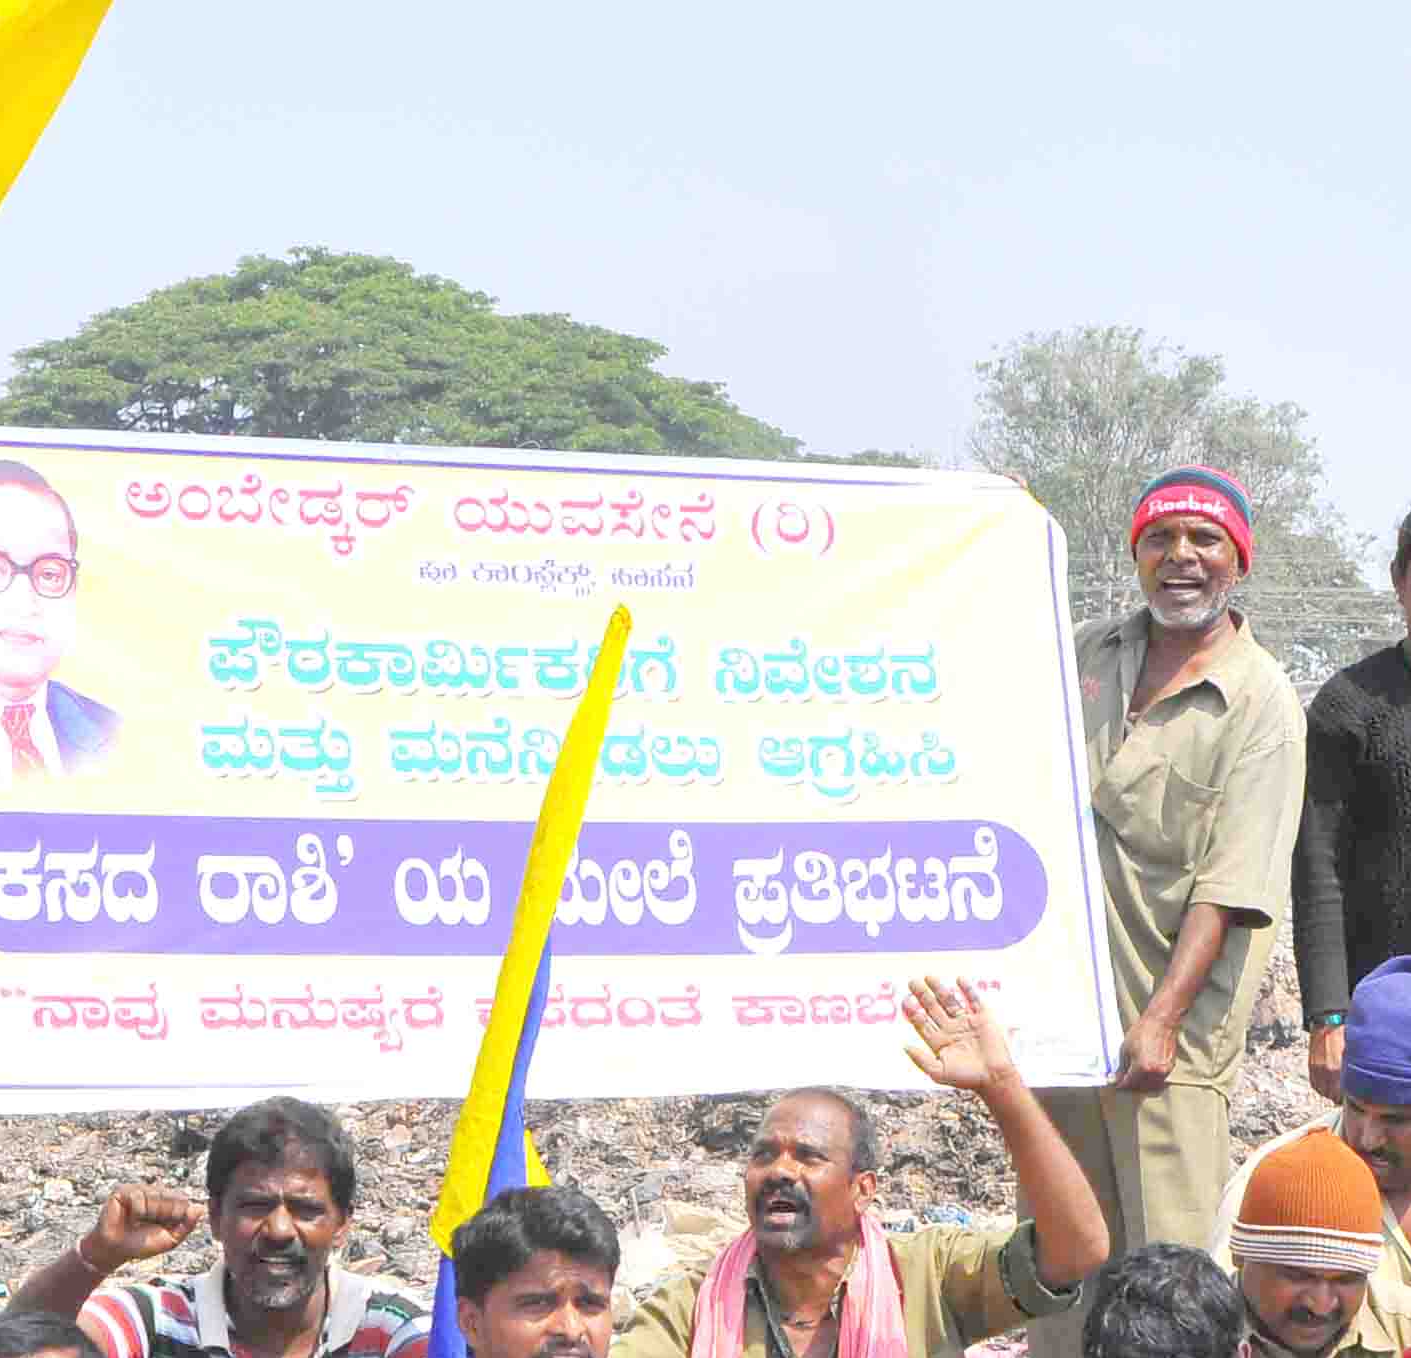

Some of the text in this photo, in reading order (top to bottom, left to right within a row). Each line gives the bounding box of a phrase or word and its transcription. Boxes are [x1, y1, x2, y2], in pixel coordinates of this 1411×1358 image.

[125, 472, 837, 557] ಅಂಬೇಡ್ಕರ್ ಯುವಸೇನೆ (ರಿ)
[207, 618, 939, 699] ಪೌರಕಾರ್ಮಿಕಗೆ ನಿವೇಶನ
[201, 716, 358, 797] ಮತ್ತು
[758, 726, 959, 798] ಆಗ್ರಹಿಸಿ
[196, 832, 355, 926] ರಾಶಿ’
[394, 843, 492, 927] ಯ
[732, 826, 1005, 954] ಪ್ರತಿಭಟನೆ
[199, 983, 446, 1053] ಮನುಷ್ಯರೆ
